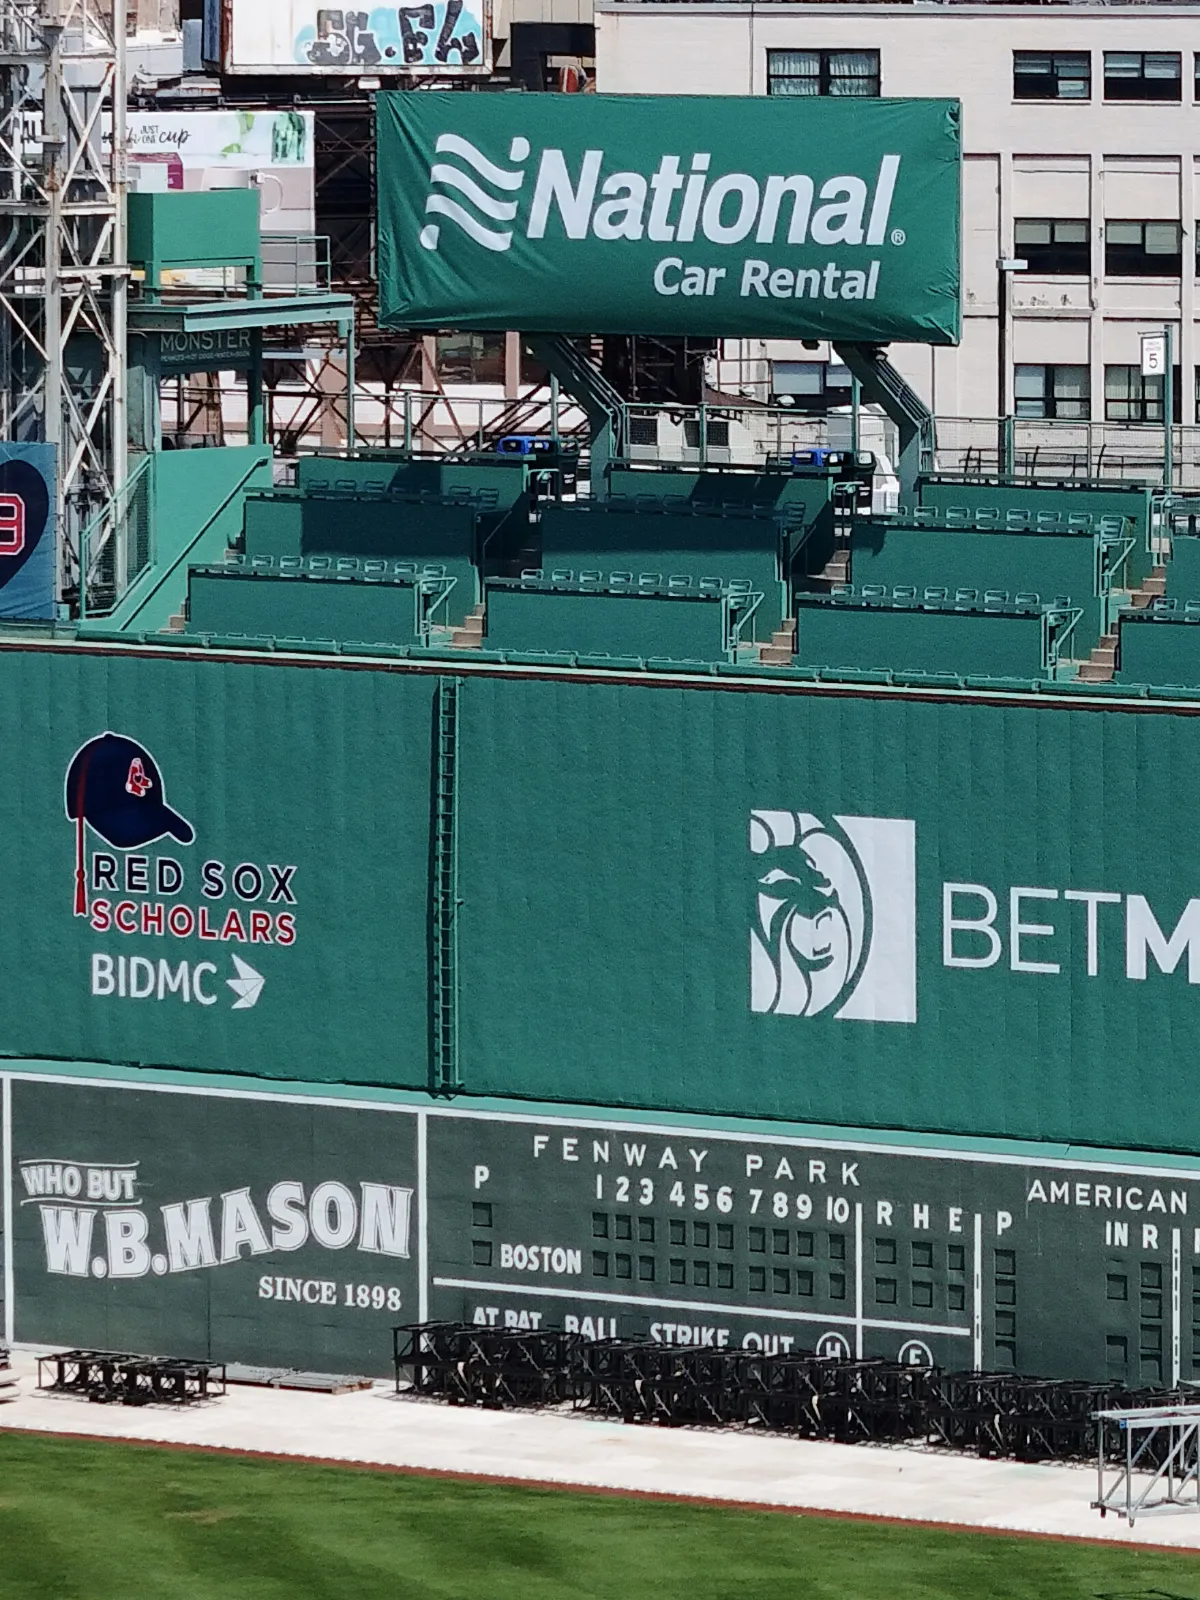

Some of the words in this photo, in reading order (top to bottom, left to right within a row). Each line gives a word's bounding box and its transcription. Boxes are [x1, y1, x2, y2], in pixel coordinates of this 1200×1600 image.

[159, 128, 192, 149] cup
[654, 257, 726, 296] Car
[741, 260, 880, 300] Rental
[160, 329, 252, 353] MONSTER
[1149, 353, 1158, 369] 5
[92, 852, 185, 895] RED
[201, 860, 298, 905] SOX
[90, 898, 297, 946] SCHOLARS
[92, 953, 217, 1005] BIDMC
[474, 1165, 490, 1189] P
[533, 1135, 708, 1173] FENWAY
[746, 1155, 860, 1186] PARK
[20, 1165, 82, 1197] WHO
[87, 1169, 137, 1200] BUT
[616, 1176, 630, 1202] 2
[639, 1178, 653, 1205] 3
[670, 1181, 685, 1207] 4
[694, 1184, 708, 1210] 5
[716, 1186, 733, 1213] 6
[749, 1189, 763, 1214] 7
[773, 1192, 788, 1218] 8
[797, 1194, 813, 1220] 9
[827, 1196, 850, 1223] 10
[1027, 1178, 1188, 1216] AMERICAN
[877, 1201, 893, 1226] R
[913, 1204, 929, 1229] H
[950, 1208, 963, 1232] E
[997, 1211, 1012, 1236] P
[1106, 1221, 1128, 1247] IN
[1142, 1224, 1158, 1249] R
[501, 1243, 582, 1274] BOSTON
[259, 1276, 337, 1305] SINCE
[344, 1284, 402, 1312] 1898
[473, 1306, 499, 1326] AT
[650, 1322, 730, 1349] STRIKE
[742, 1331, 794, 1357] OUT
